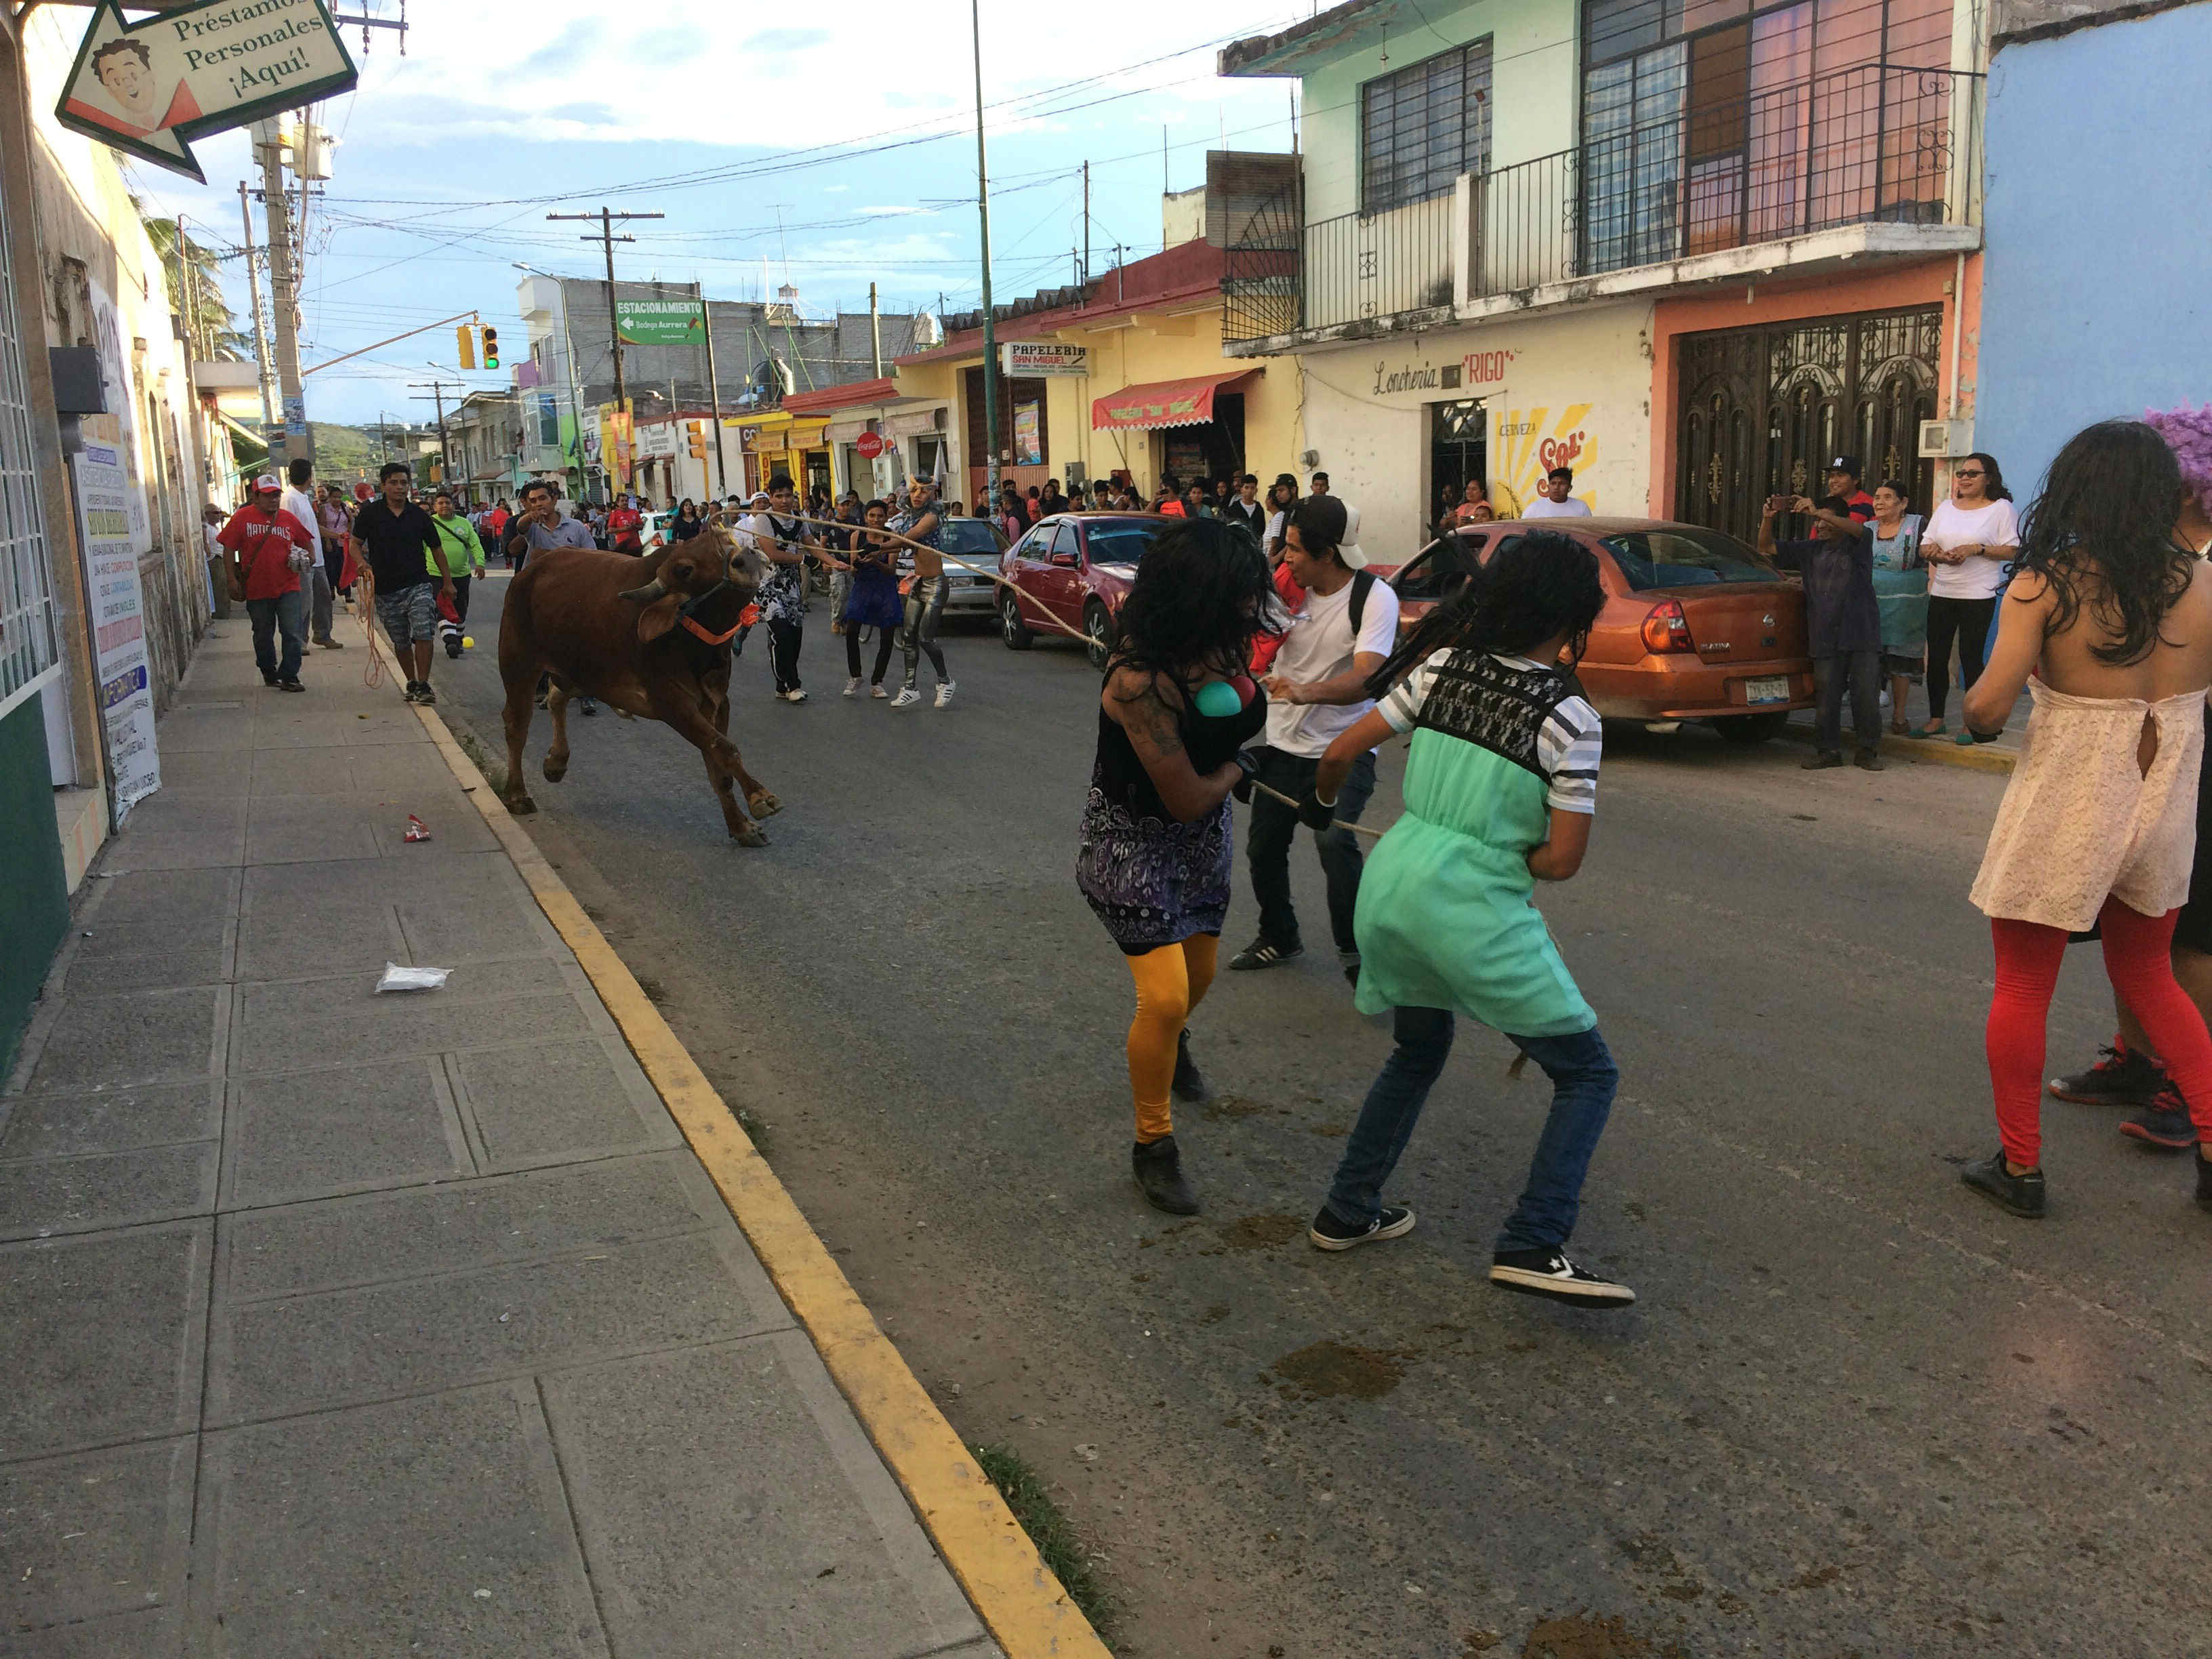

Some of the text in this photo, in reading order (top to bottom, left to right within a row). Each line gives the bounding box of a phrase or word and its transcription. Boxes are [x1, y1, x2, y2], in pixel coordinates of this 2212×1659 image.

[184, 17, 323, 70] Personales
[229, 47, 310, 98] ¡Aquí!
[617, 302, 701, 314] ESTACIONAMIENTO
[636, 321, 657, 330] Bodega
[1012, 345, 1086, 356] PAPELERIA
[1012, 355, 1067, 365] SAN MIGUEL
[1373, 361, 1439, 396] Loncheria
[1500, 423, 1536, 436] CERVEZA
[857, 440, 881, 451] Coca-Cola
